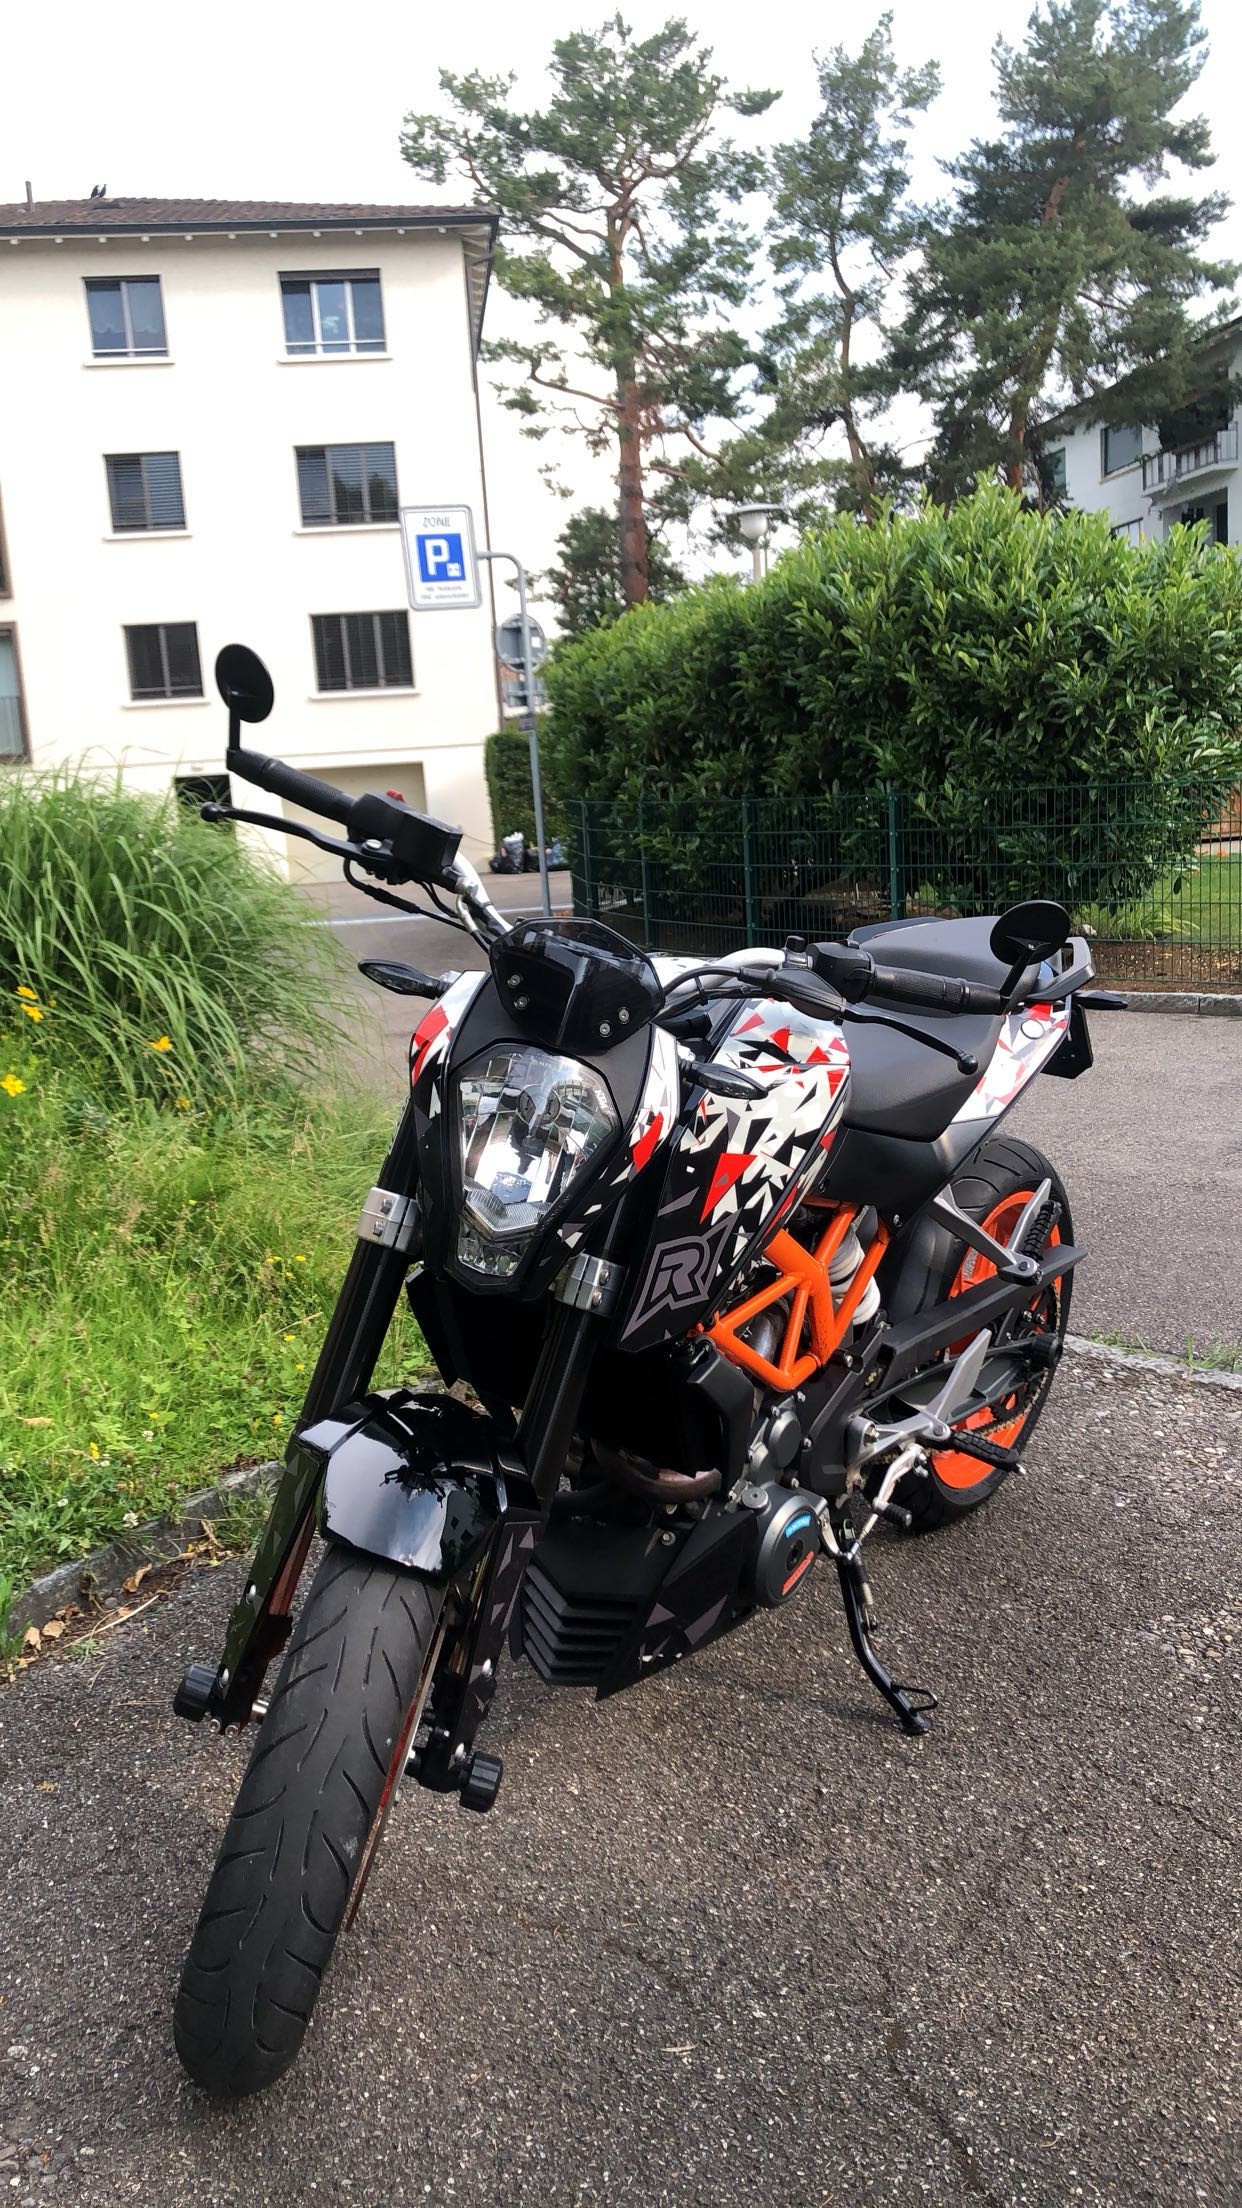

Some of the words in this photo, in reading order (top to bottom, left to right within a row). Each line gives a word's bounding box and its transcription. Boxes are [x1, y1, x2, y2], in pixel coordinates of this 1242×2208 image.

[422, 516, 451, 528] ZONE
[424, 538, 450, 576] P
[648, 1245, 705, 1303] R
